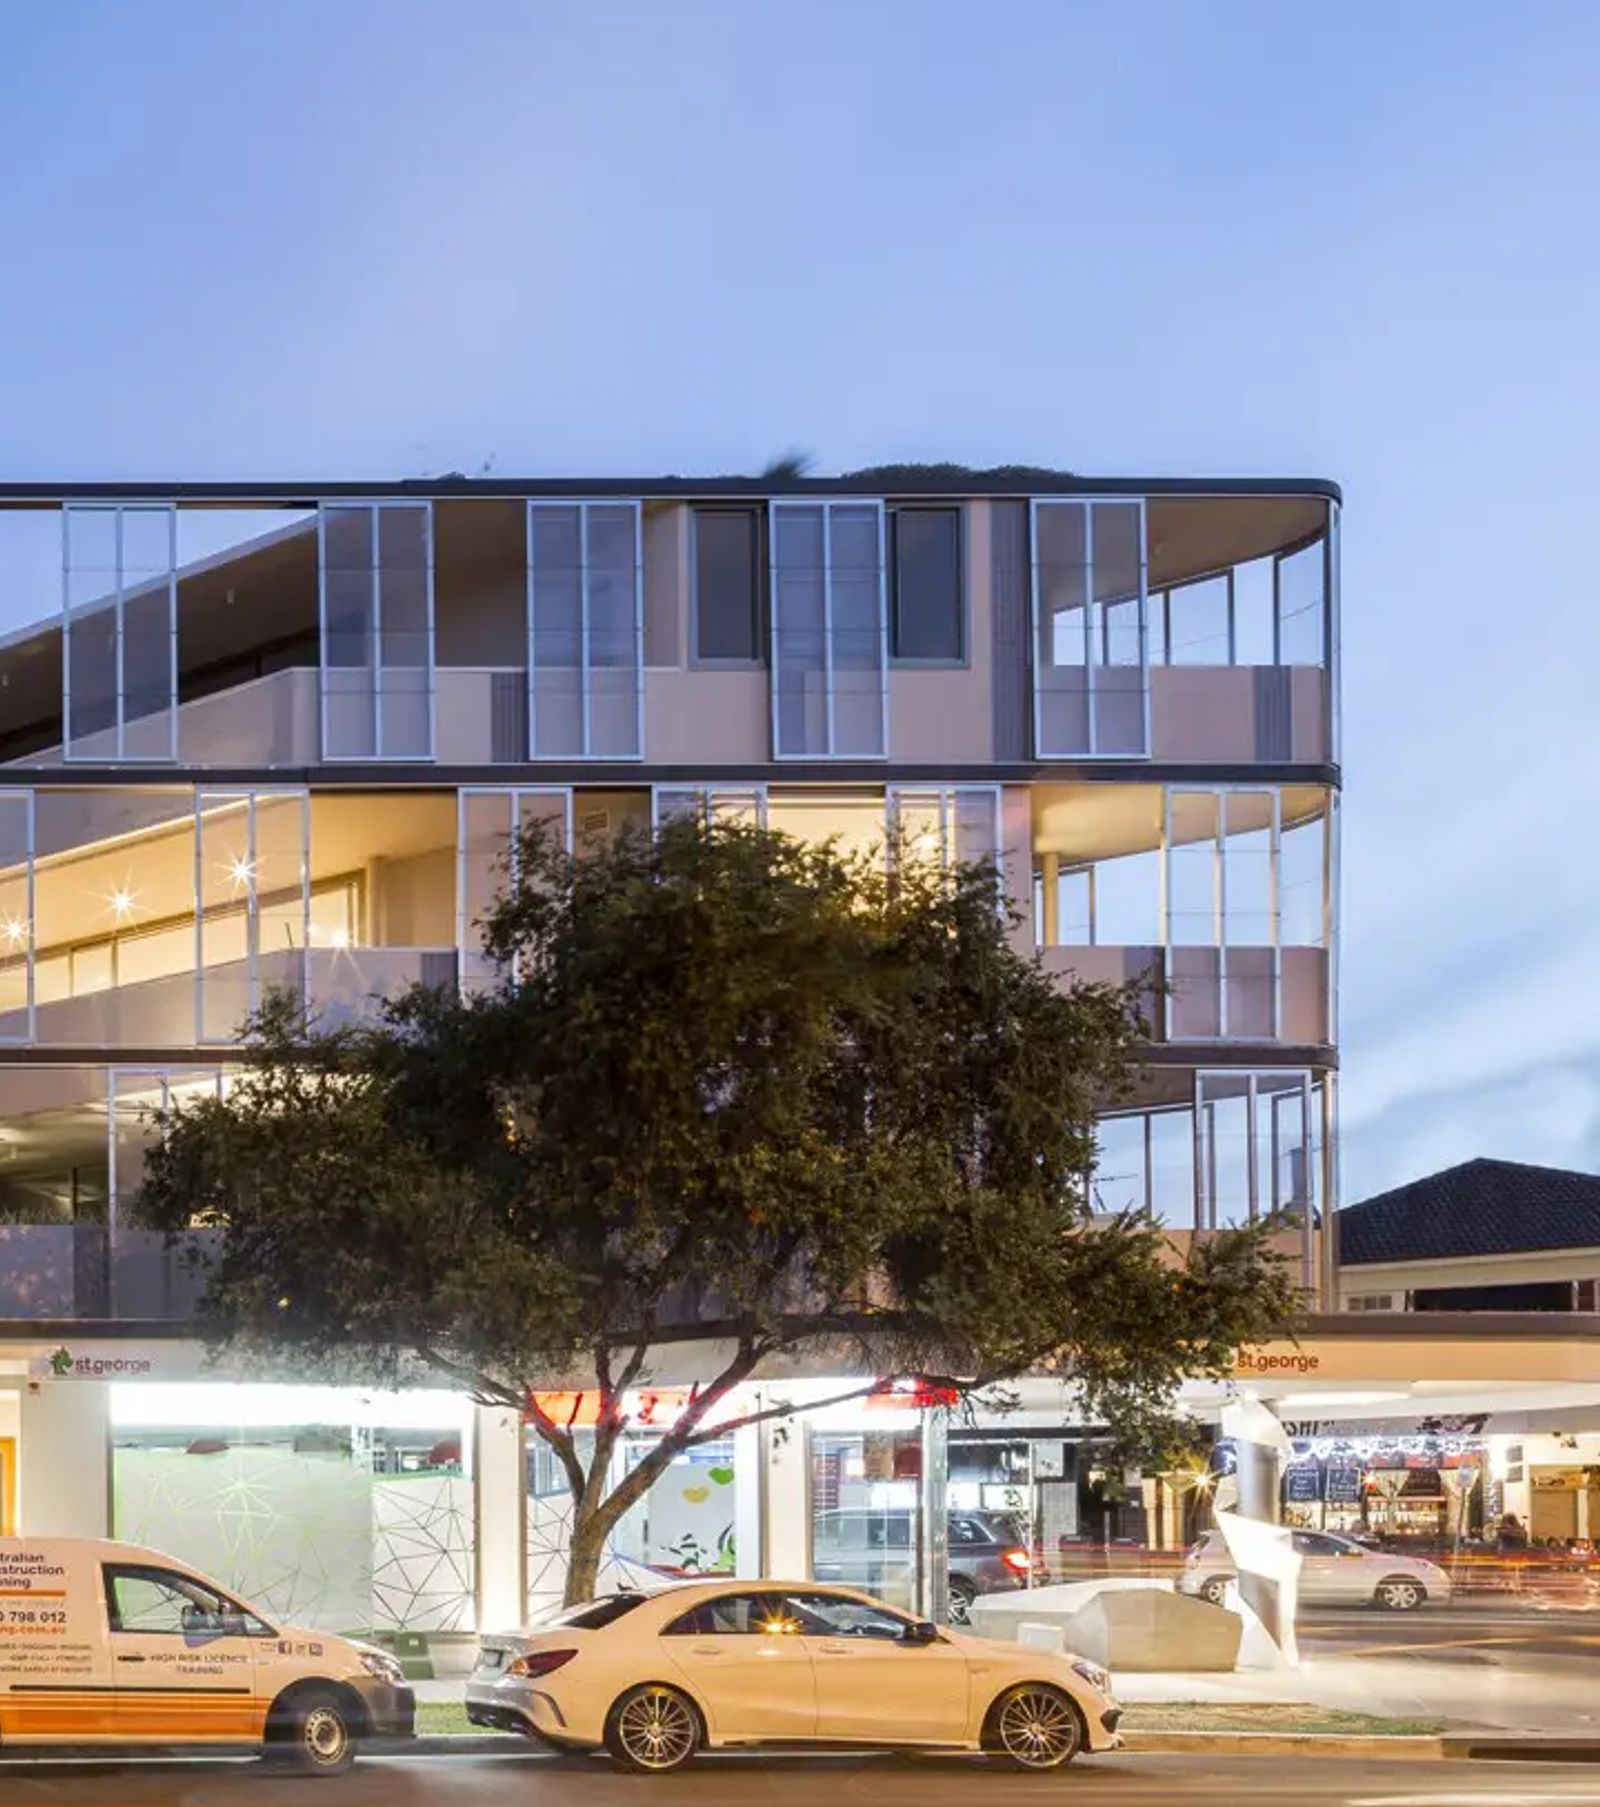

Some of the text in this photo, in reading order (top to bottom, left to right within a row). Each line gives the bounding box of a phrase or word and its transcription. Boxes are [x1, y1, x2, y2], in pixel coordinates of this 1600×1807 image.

[75, 1357, 150, 1374] st.george
[1238, 1354, 1319, 1372] st.george
[10, 1611, 36, 1622] 798
[40, 1611, 66, 1623] 012
